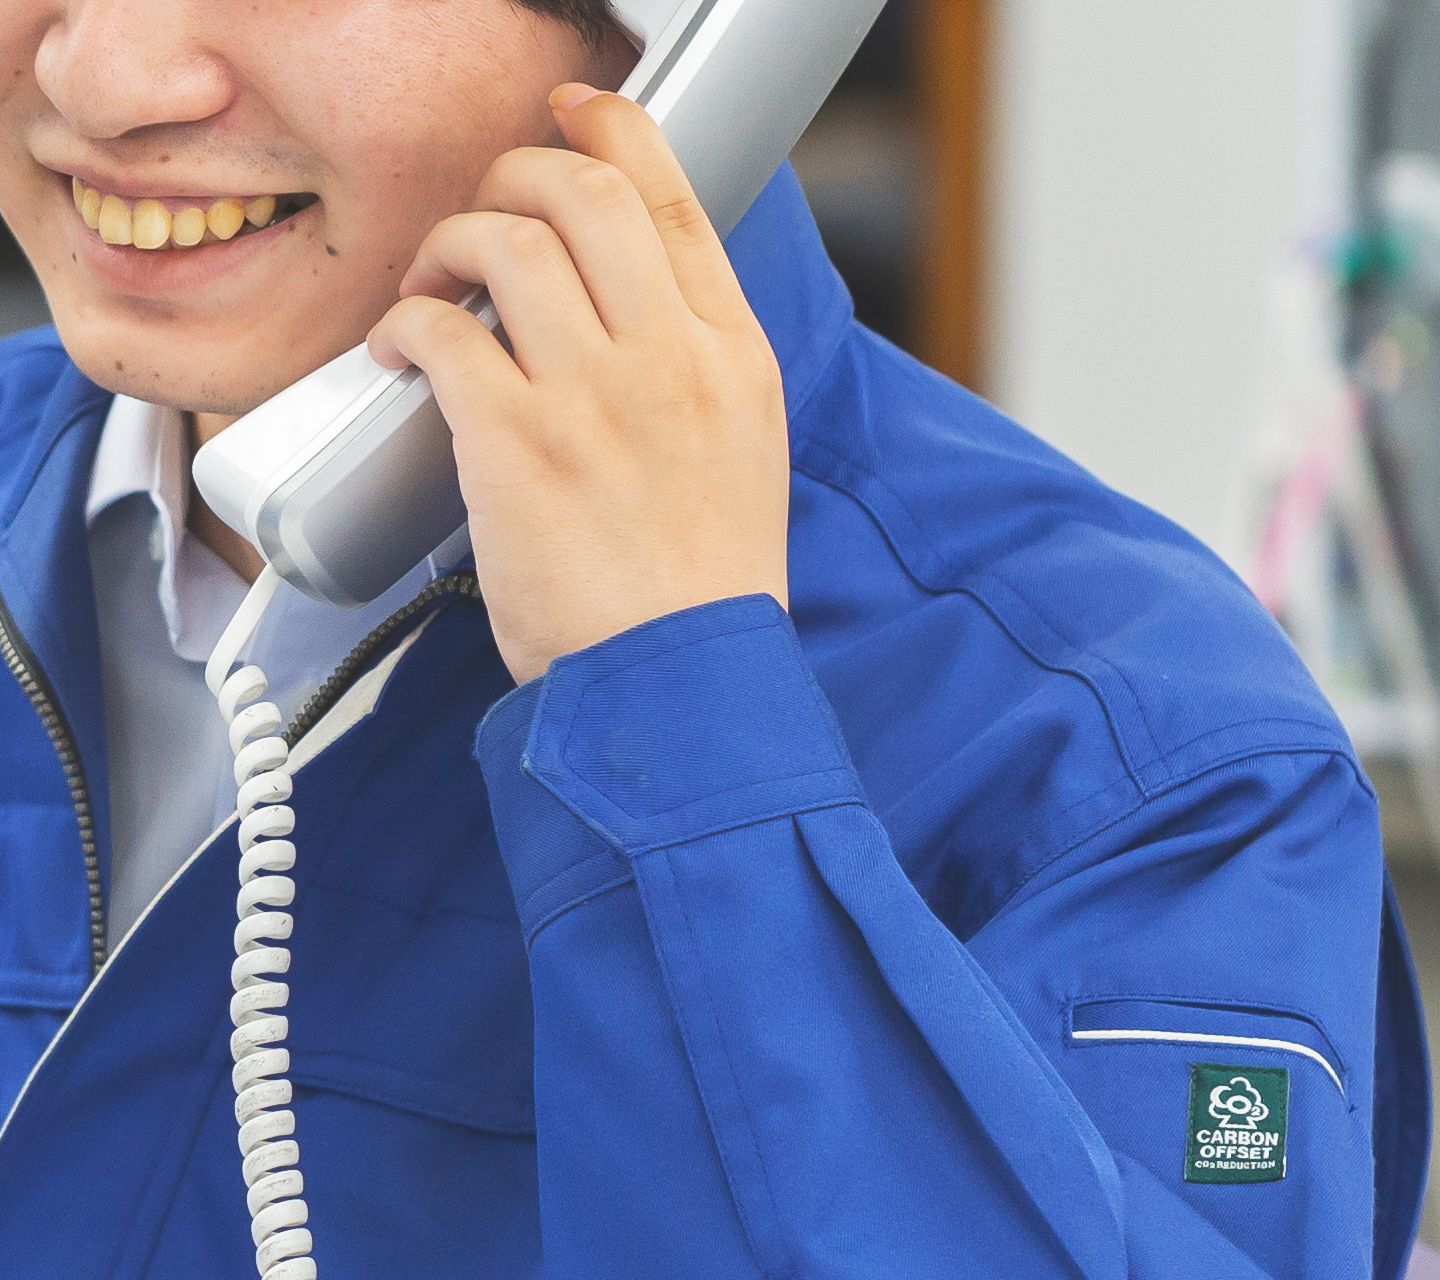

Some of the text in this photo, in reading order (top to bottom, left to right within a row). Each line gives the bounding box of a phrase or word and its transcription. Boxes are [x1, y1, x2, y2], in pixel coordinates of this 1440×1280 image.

[1195, 1129, 1279, 1147] CARBON
[1199, 1145, 1273, 1160] OFFSET
[1216, 1160, 1276, 1170] REDUCTION
